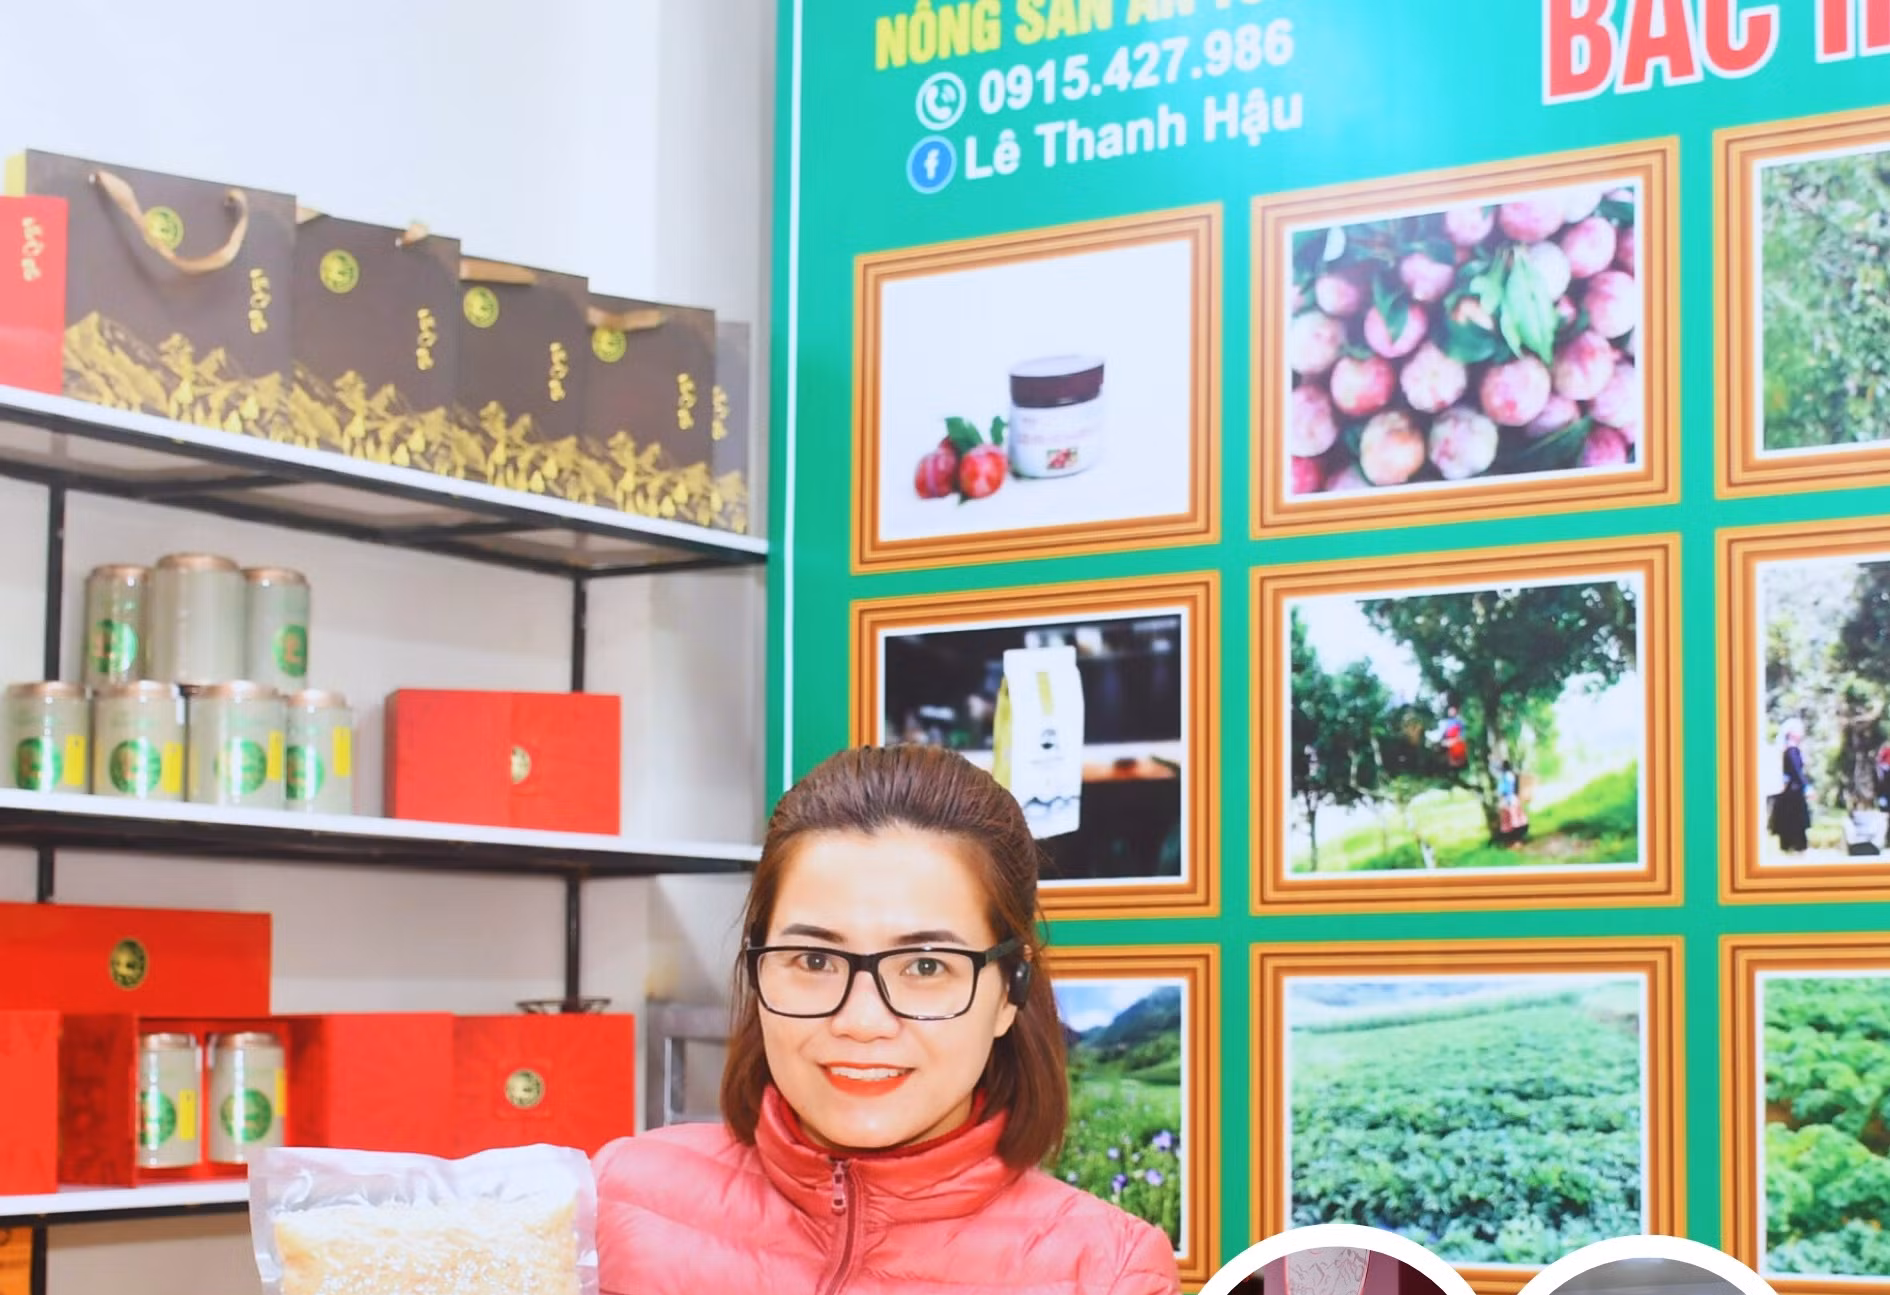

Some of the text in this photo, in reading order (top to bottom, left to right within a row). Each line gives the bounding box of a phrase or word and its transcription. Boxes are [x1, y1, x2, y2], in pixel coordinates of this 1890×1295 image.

[979, 18, 1294, 114] 0915.427.986
[965, 88, 1303, 180] Lê Thanh Hậu
